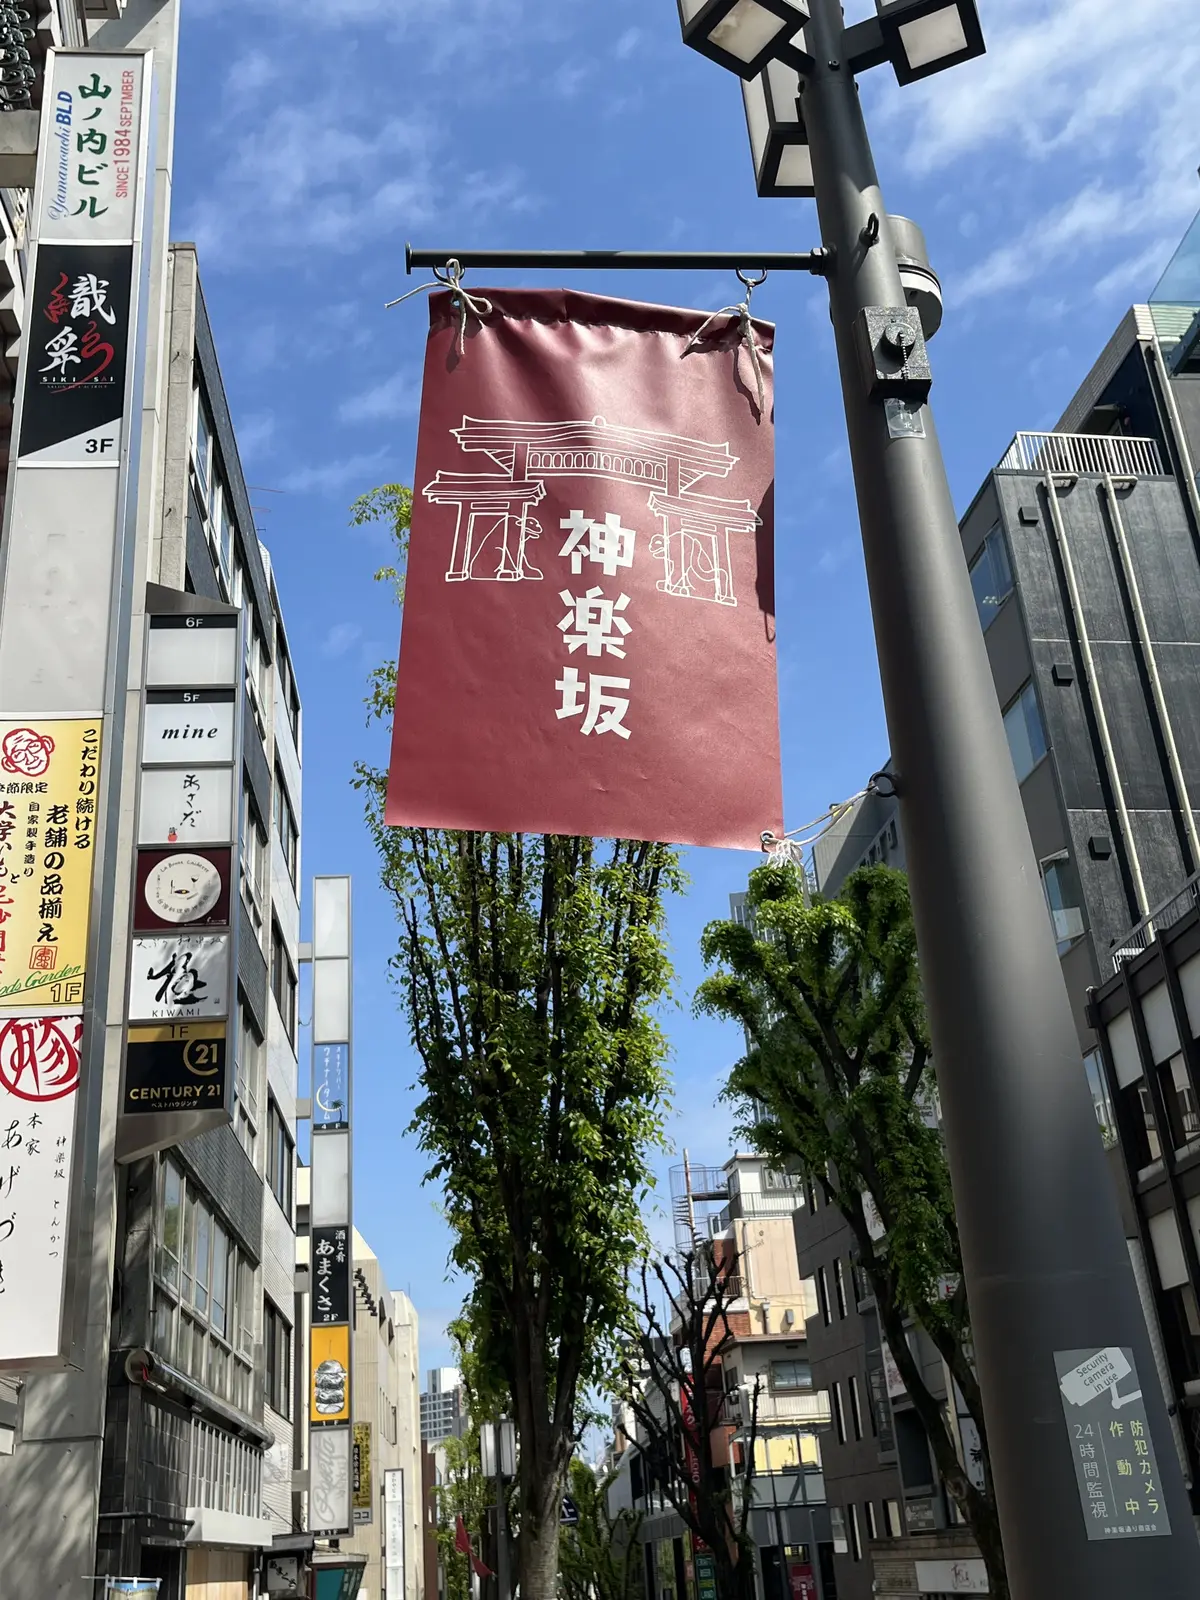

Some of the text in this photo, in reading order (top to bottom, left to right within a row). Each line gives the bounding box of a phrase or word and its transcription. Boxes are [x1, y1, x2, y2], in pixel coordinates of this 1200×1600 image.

[48, 91, 73, 221] Yamanouchi BLD
[70, 73, 112, 219] 山ノ内ビル
[113, 129, 132, 165] 1984
[116, 166, 130, 198] SINCE
[85, 438, 114, 453] 3F
[185, 617, 204, 627] 6F
[555, 510, 636, 740] 神楽坂
[183, 693, 200, 702] 5F
[162, 724, 218, 739] mine
[74, 729, 98, 849] こだわり続ける
[37, 804, 70, 943] 老舗の品揃え
[25, 963, 81, 988] Garden
[51, 983, 82, 1002] 1F
[152, 1009, 200, 1018] KIWAMI
[169, 1025, 189, 1038] 1F
[129, 1084, 221, 1100] CENTURY 21
[25, 1112, 43, 1156] 本家
[0, 1120, 23, 1293] あげづ
[49, 1200, 61, 1258] とんかつ
[335, 1229, 346, 1263] 酒と肴
[315, 1239, 335, 1311] あまくさ
[323, 1313, 338, 1321] 2F
[1076, 1353, 1109, 1378] Security
[1083, 1362, 1115, 1387] camera
[1093, 1373, 1119, 1393] in use
[1073, 1424, 1108, 1518] 24時間監視
[1109, 1421, 1140, 1516] 作動中
[1130, 1420, 1159, 1514] 防犯カメラ
